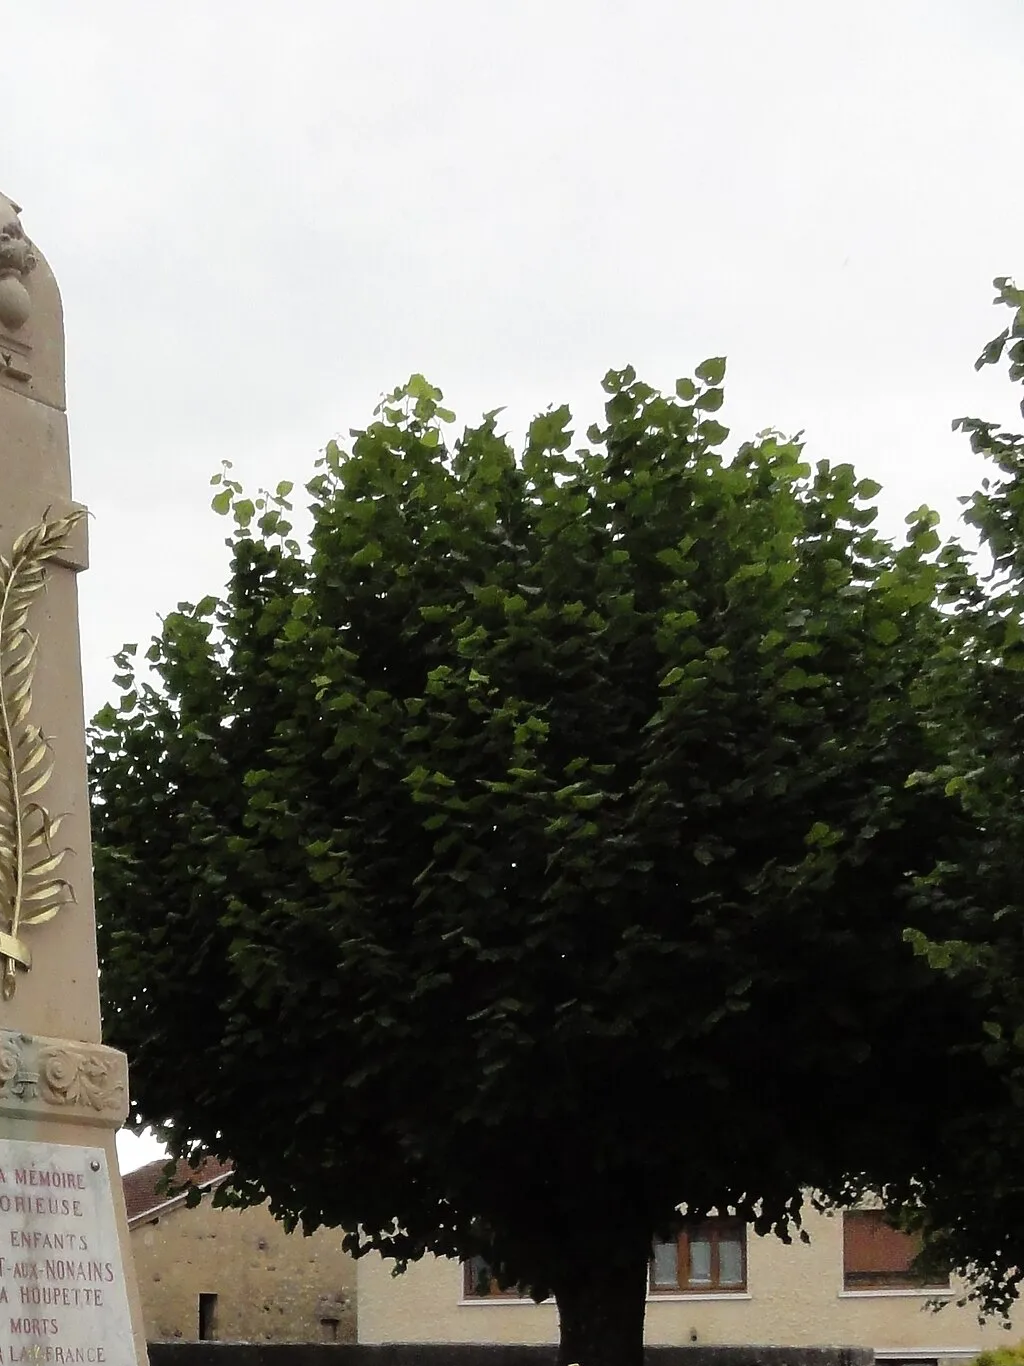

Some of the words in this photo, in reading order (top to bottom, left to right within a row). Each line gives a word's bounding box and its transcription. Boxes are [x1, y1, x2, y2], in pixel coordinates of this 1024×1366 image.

[15, 1161, 85, 1190] MÉMOIRE
[10, 1230, 88, 1250] ENFANTS
[20, 1286, 104, 1306] HOUPETTE
[10, 1318, 59, 1335] MORTS
[10, 1346, 27, 1363] LA
[46, 1346, 106, 1364] FRANCE
